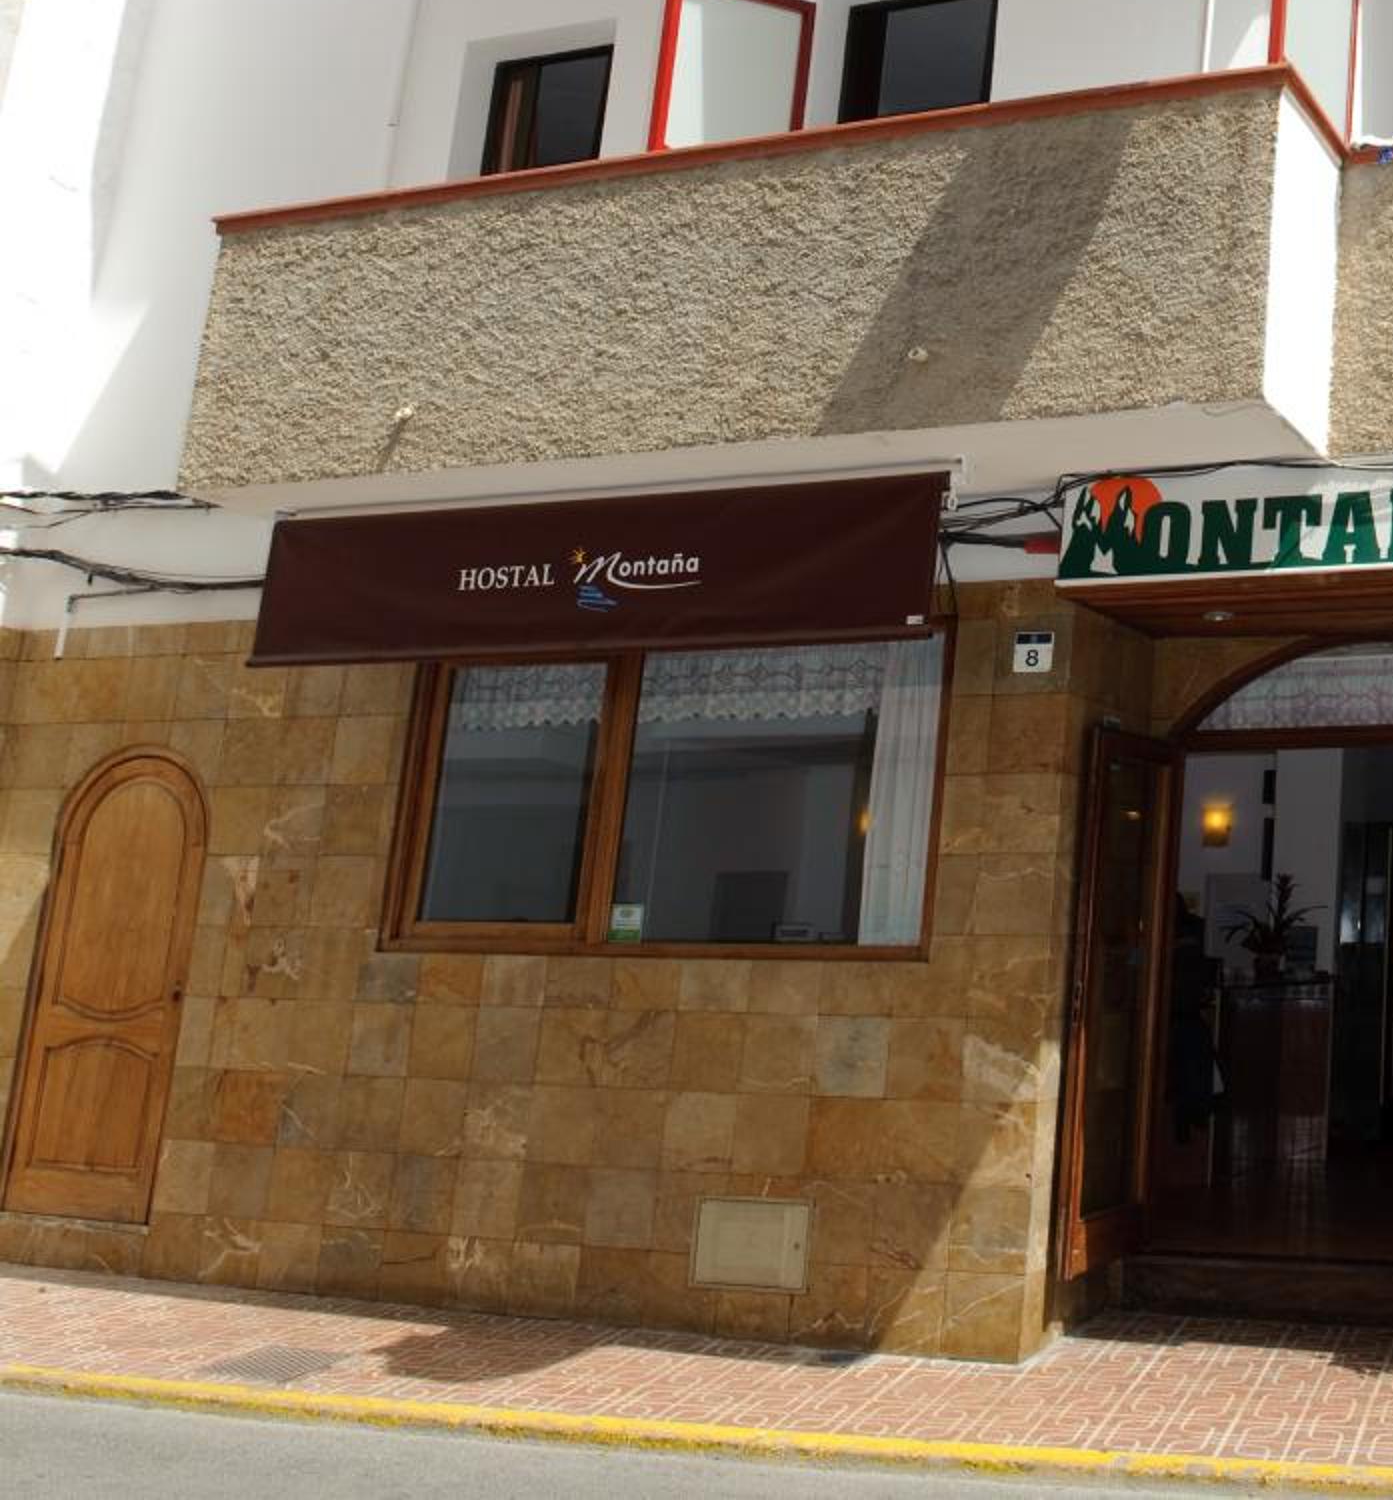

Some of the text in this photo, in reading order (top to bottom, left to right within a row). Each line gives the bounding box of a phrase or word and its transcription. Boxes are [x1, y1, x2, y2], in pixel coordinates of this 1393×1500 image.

[458, 551, 702, 590] HOSTAL Montaña
[1025, 649, 1039, 667] 8
